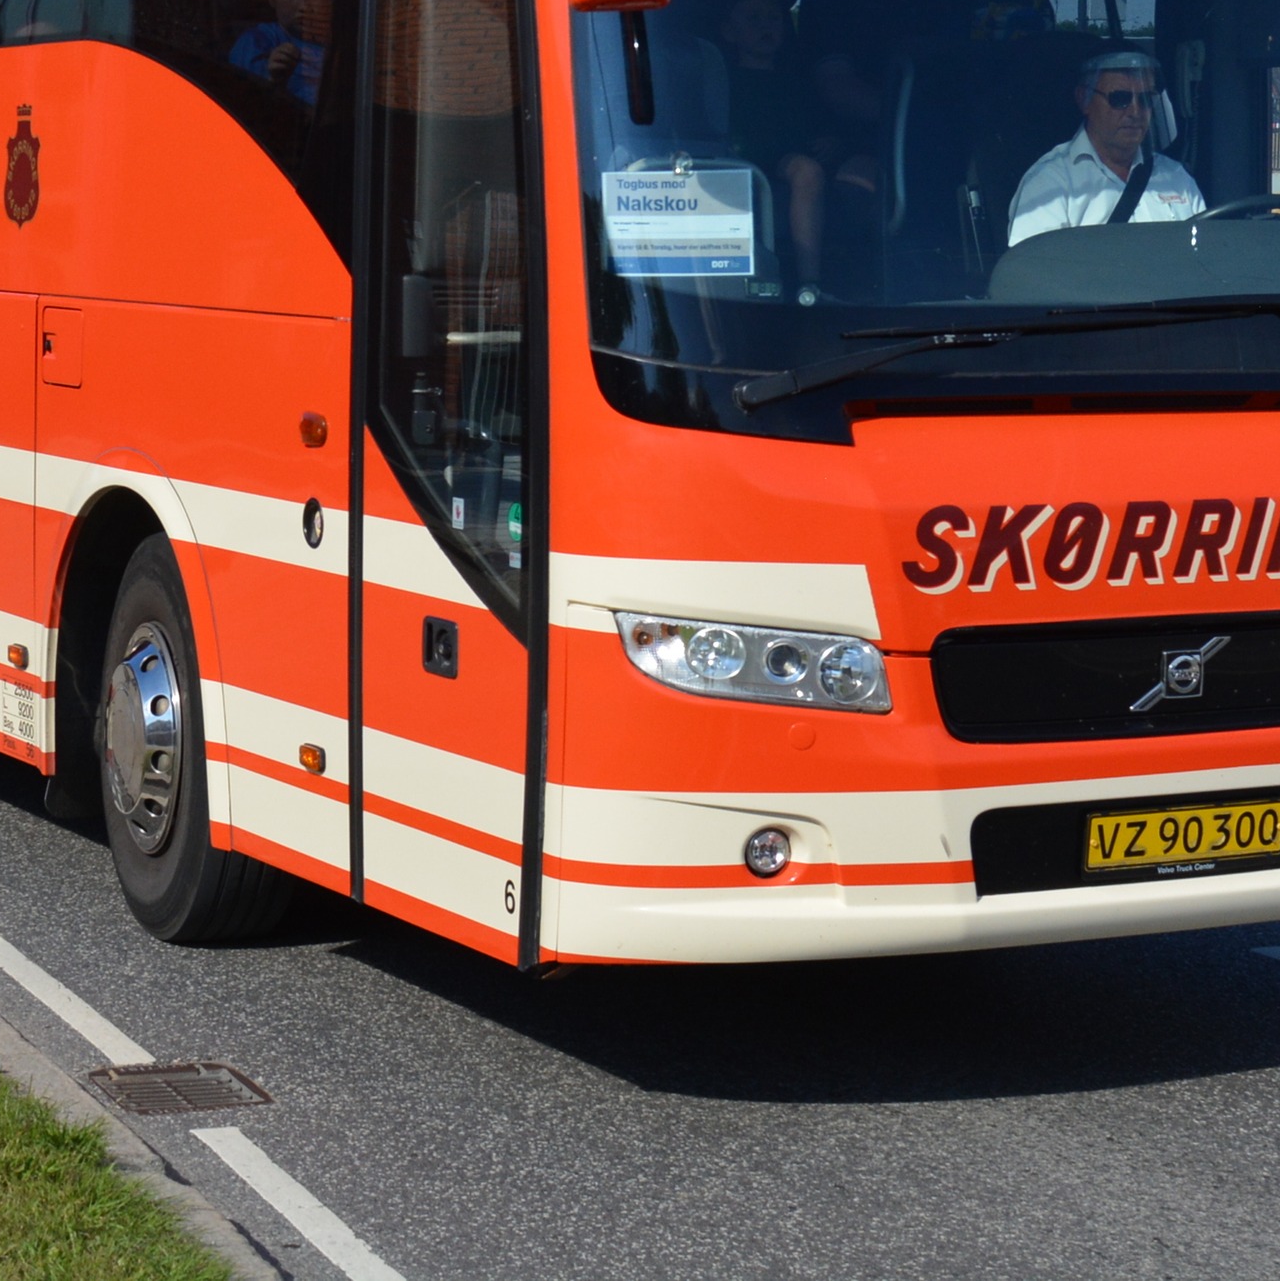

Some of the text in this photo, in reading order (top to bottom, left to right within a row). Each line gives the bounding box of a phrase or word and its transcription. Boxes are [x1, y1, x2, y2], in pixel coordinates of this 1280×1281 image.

[616, 178, 686, 191] Togbus mod
[616, 195, 698, 212] Nakskov
[1097, 807, 1280, 860] VZ 90 300
[1157, 862, 1216, 875] Volvo Truck Center
[504, 879, 516, 914] 6
